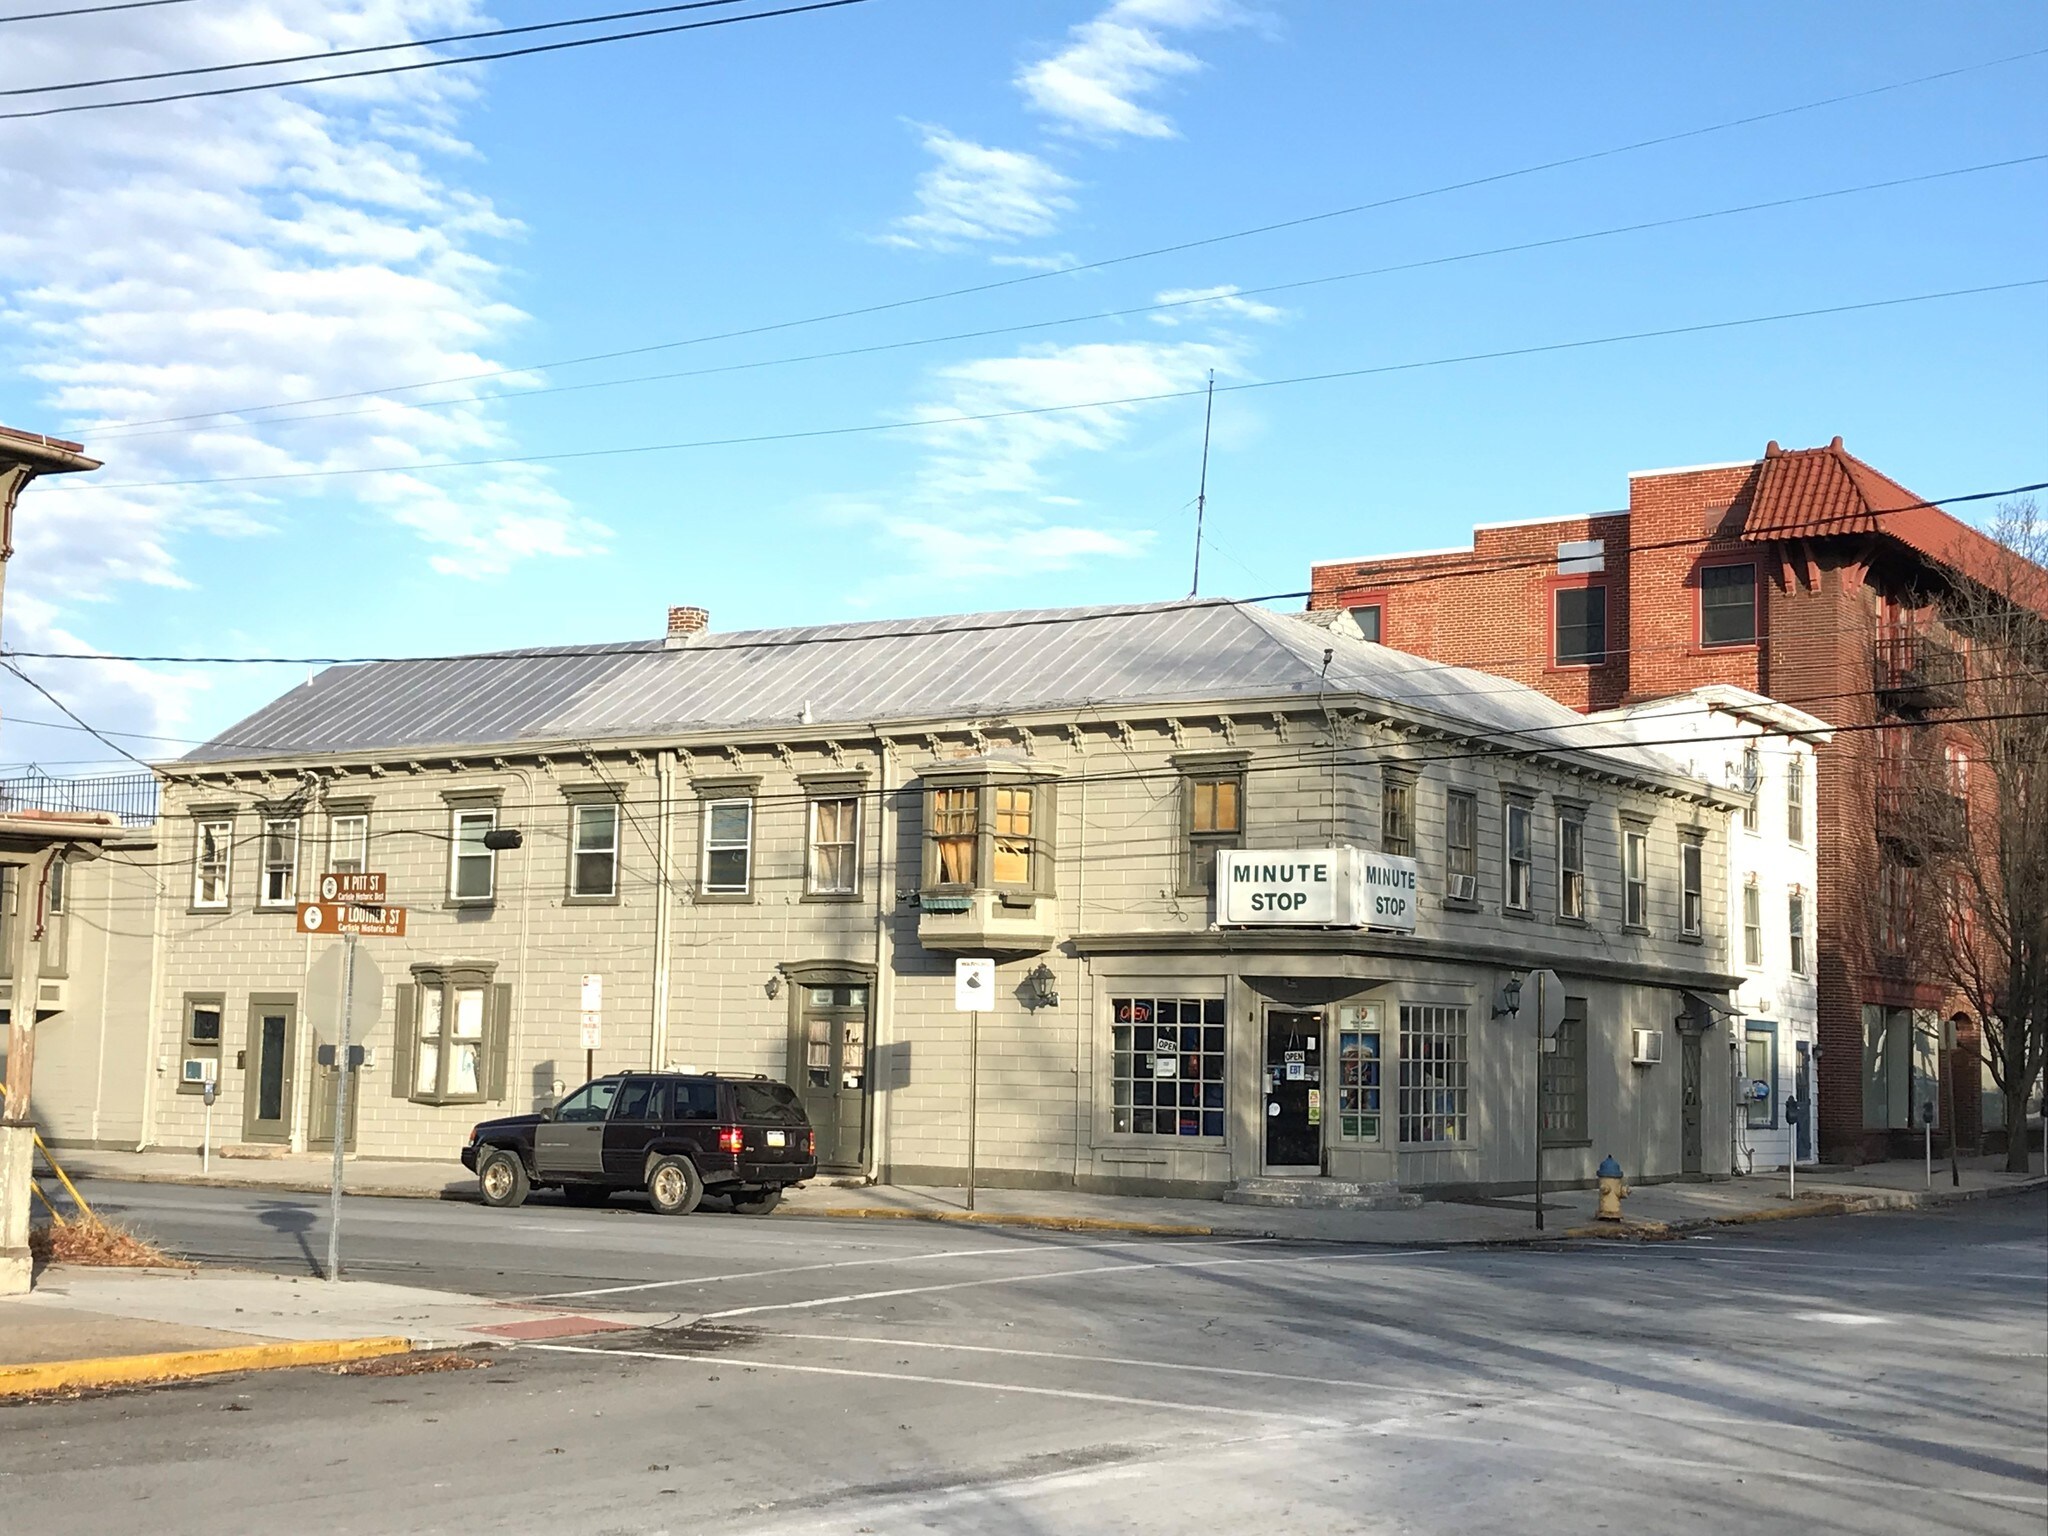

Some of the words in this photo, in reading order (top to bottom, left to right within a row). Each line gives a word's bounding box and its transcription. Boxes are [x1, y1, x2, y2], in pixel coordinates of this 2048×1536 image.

[1233, 864, 1328, 883] MINUTE
[1366, 865, 1416, 890] MINUTE
[343, 875, 349, 890] N
[352, 875, 368, 890] PITT
[370, 875, 379, 890] ST
[338, 892, 355, 900] Carlisle
[1251, 892, 1307, 911] STOP
[1375, 896, 1406, 916] STOP
[337, 906, 346, 922] W
[389, 909, 400, 924] ST
[338, 923, 359, 932] Carlisle
[361, 924, 384, 933] Historic
[1285, 1052, 1303, 1060] OPEN
[1290, 1065, 1301, 1074] EBT
